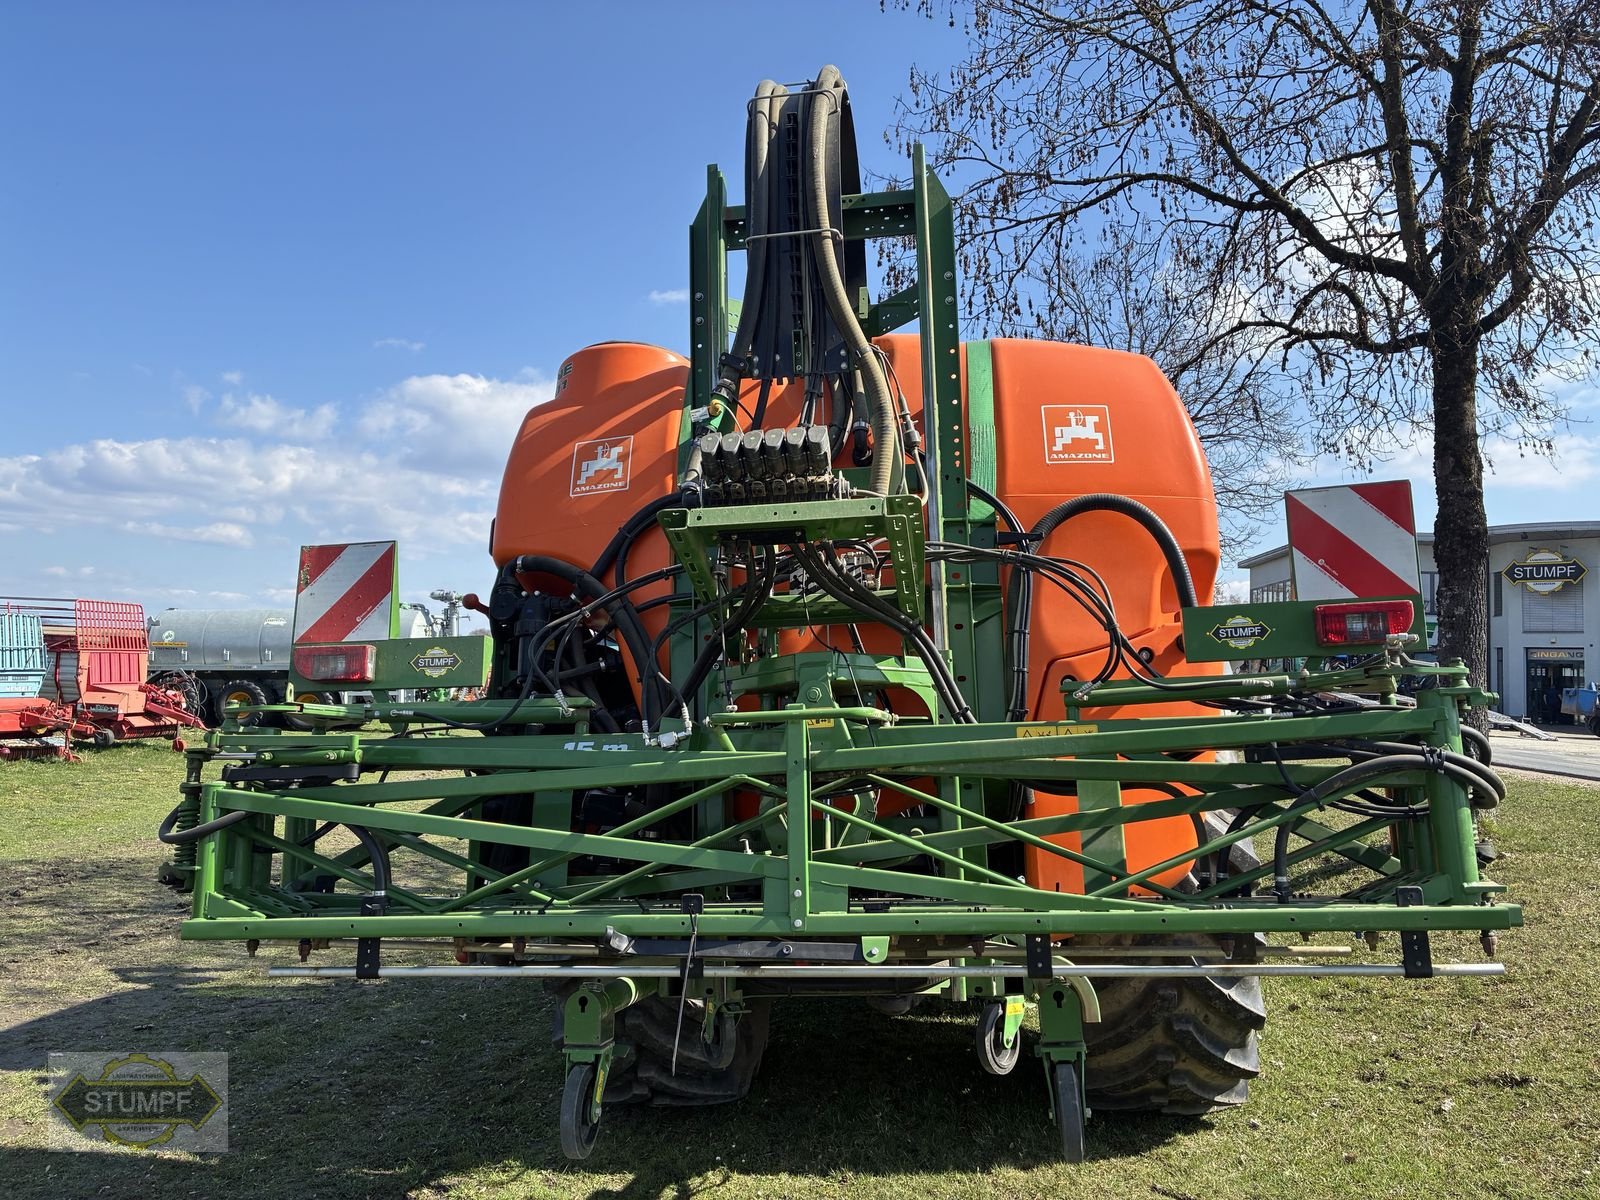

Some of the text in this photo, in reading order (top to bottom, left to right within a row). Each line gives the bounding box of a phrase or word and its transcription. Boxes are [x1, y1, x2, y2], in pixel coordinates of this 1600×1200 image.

[574, 481, 625, 493] AMAZONE
[1514, 565, 1577, 579] STUMPF
[1219, 626, 1262, 638] STUMPF
[418, 657, 455, 667] STUMPF
